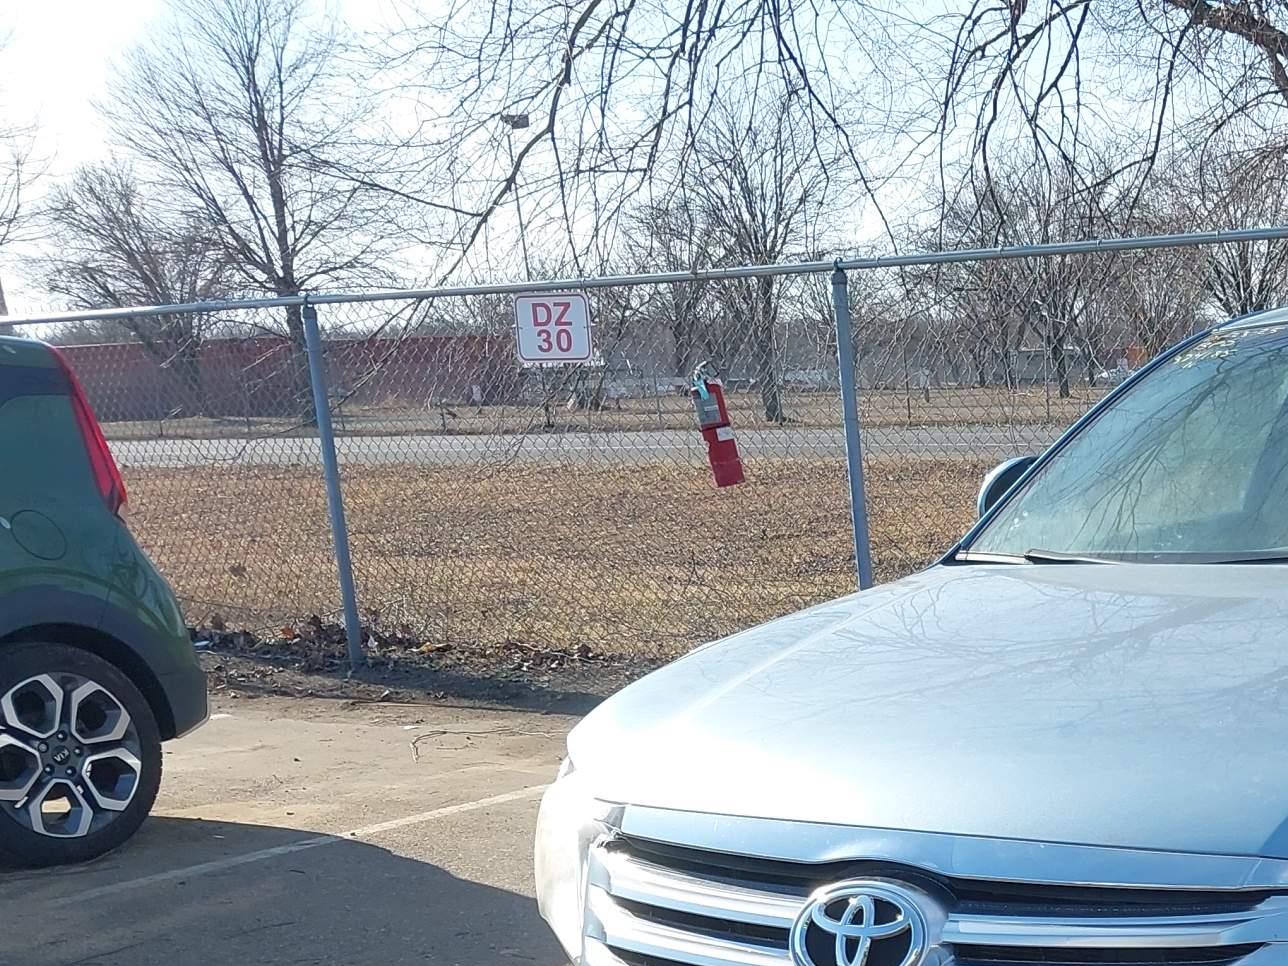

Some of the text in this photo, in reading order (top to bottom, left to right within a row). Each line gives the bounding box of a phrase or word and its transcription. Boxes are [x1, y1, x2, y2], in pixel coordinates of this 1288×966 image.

[532, 302, 573, 327] DZ
[537, 329, 573, 353] 30
[54, 748, 70, 762] KIA
